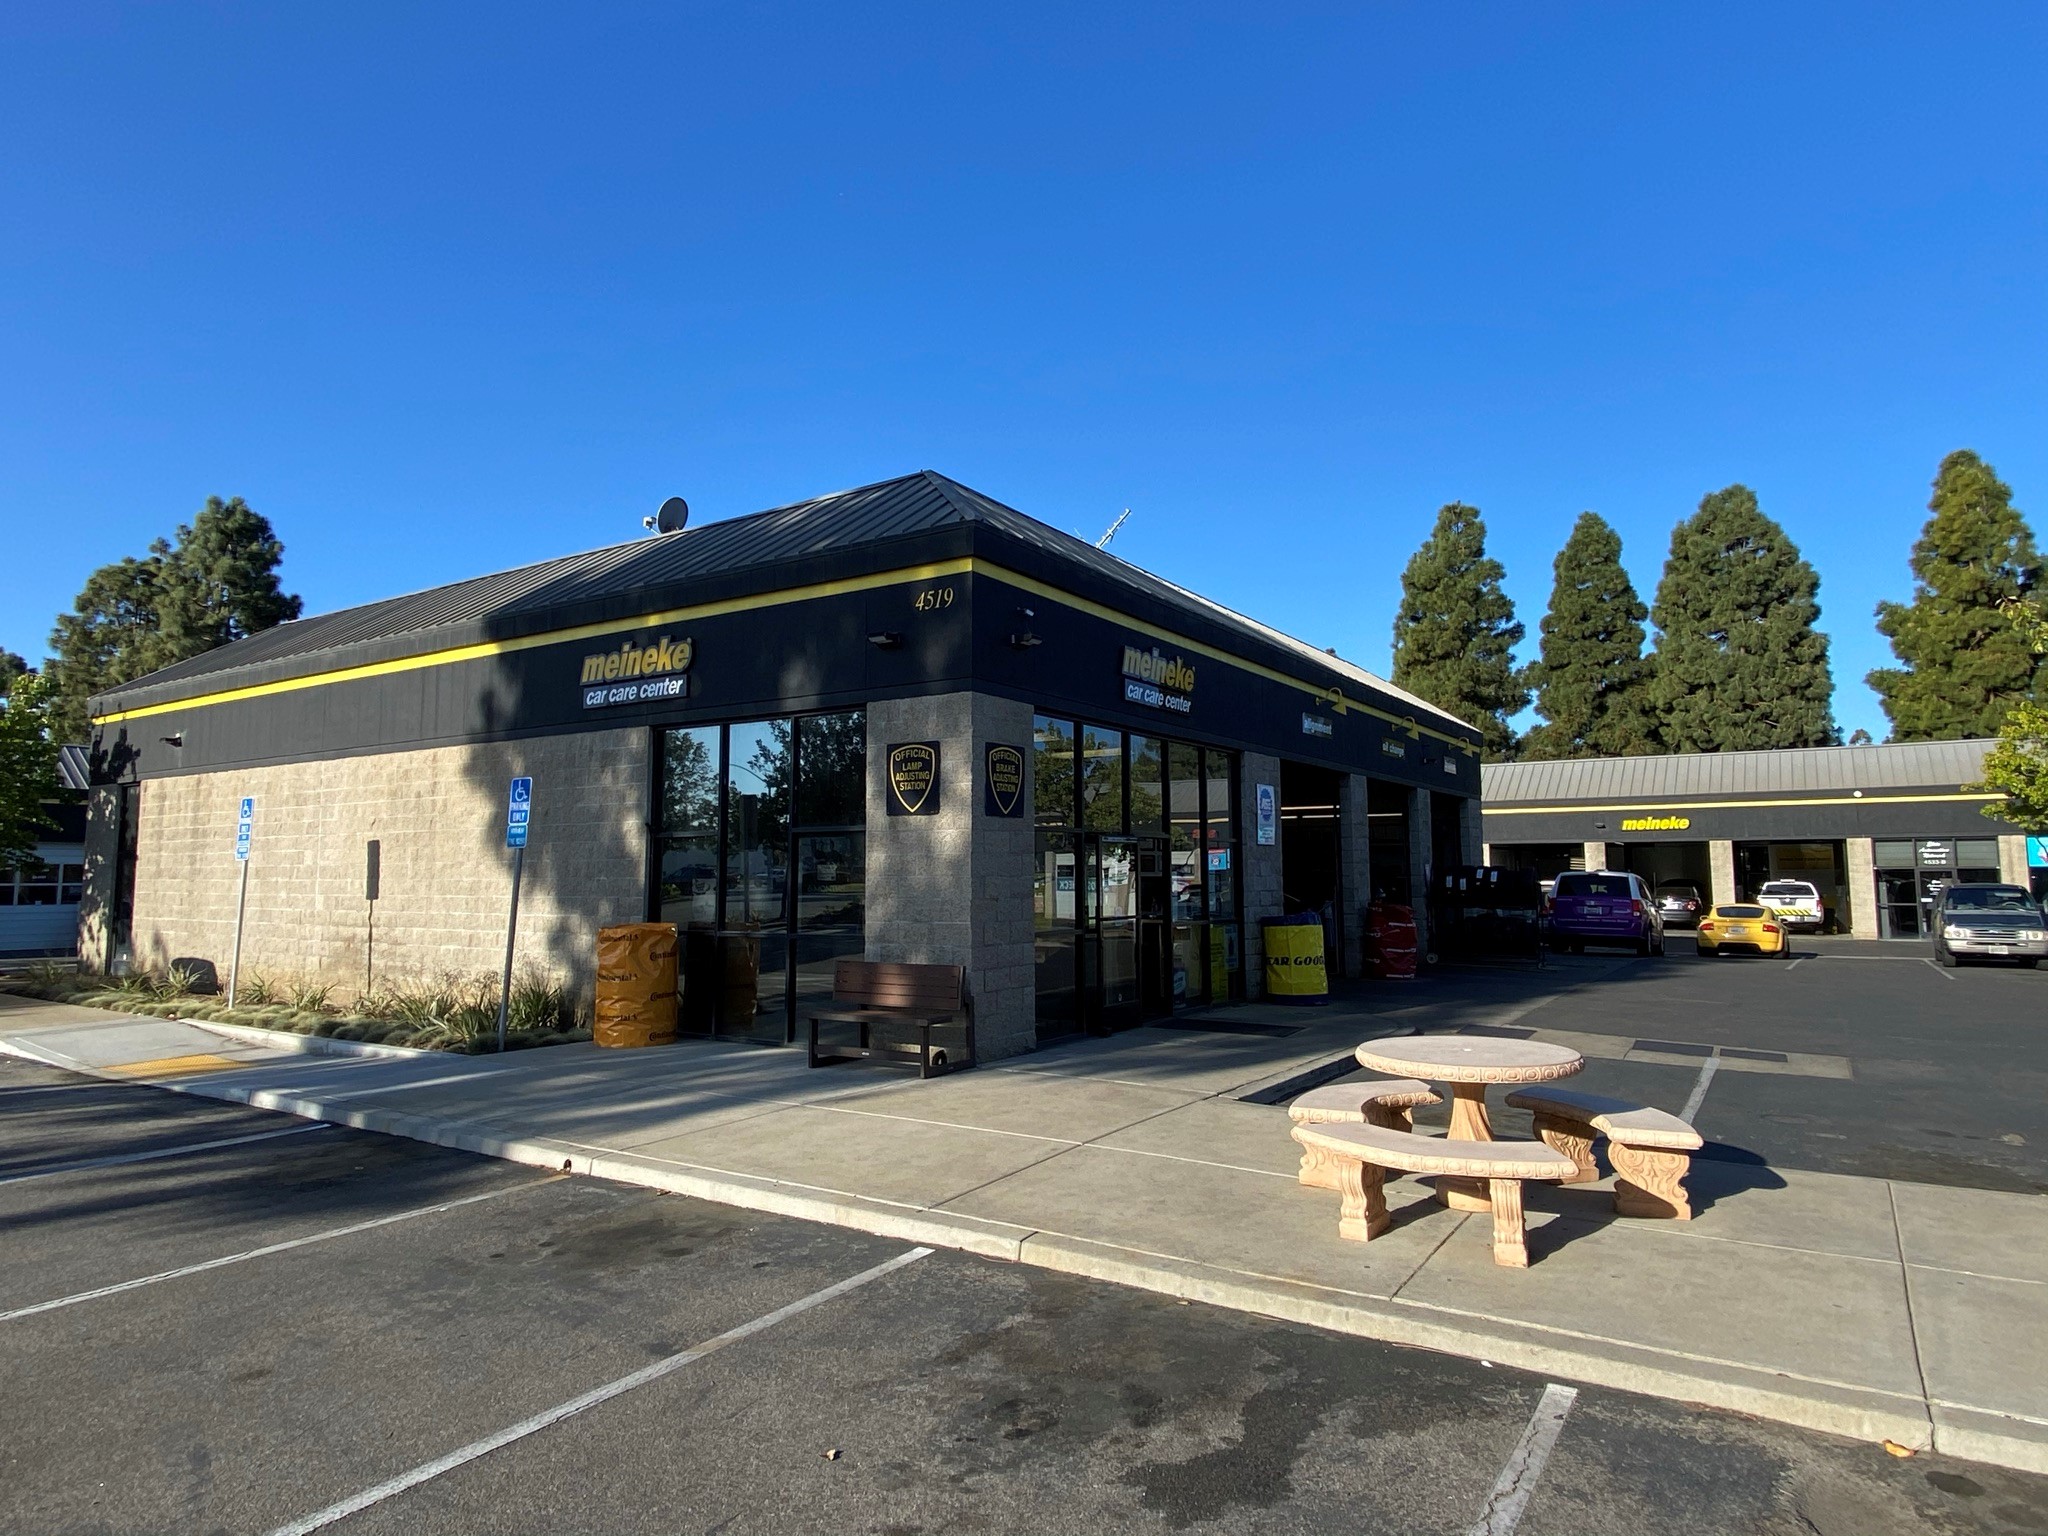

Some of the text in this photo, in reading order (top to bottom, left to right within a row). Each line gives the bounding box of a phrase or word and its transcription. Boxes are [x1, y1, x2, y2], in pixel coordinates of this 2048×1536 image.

[915, 587, 954, 611] 4519
[581, 637, 692, 684] meineke
[1122, 646, 1196, 692] meineke
[586, 677, 684, 706] car care center
[1127, 684, 1192, 713] car care center
[894, 748, 931, 762] OFFICIAL
[992, 752, 1020, 765] OFFICIAL
[902, 761, 923, 772] LAMP
[995, 763, 1016, 774] BRAKE
[895, 771, 930, 782] ADJUSTING
[992, 773, 1019, 784] ADJUSTING
[899, 781, 926, 792] STATION
[996, 782, 1016, 793] STATION
[1621, 815, 1690, 831] meineke
